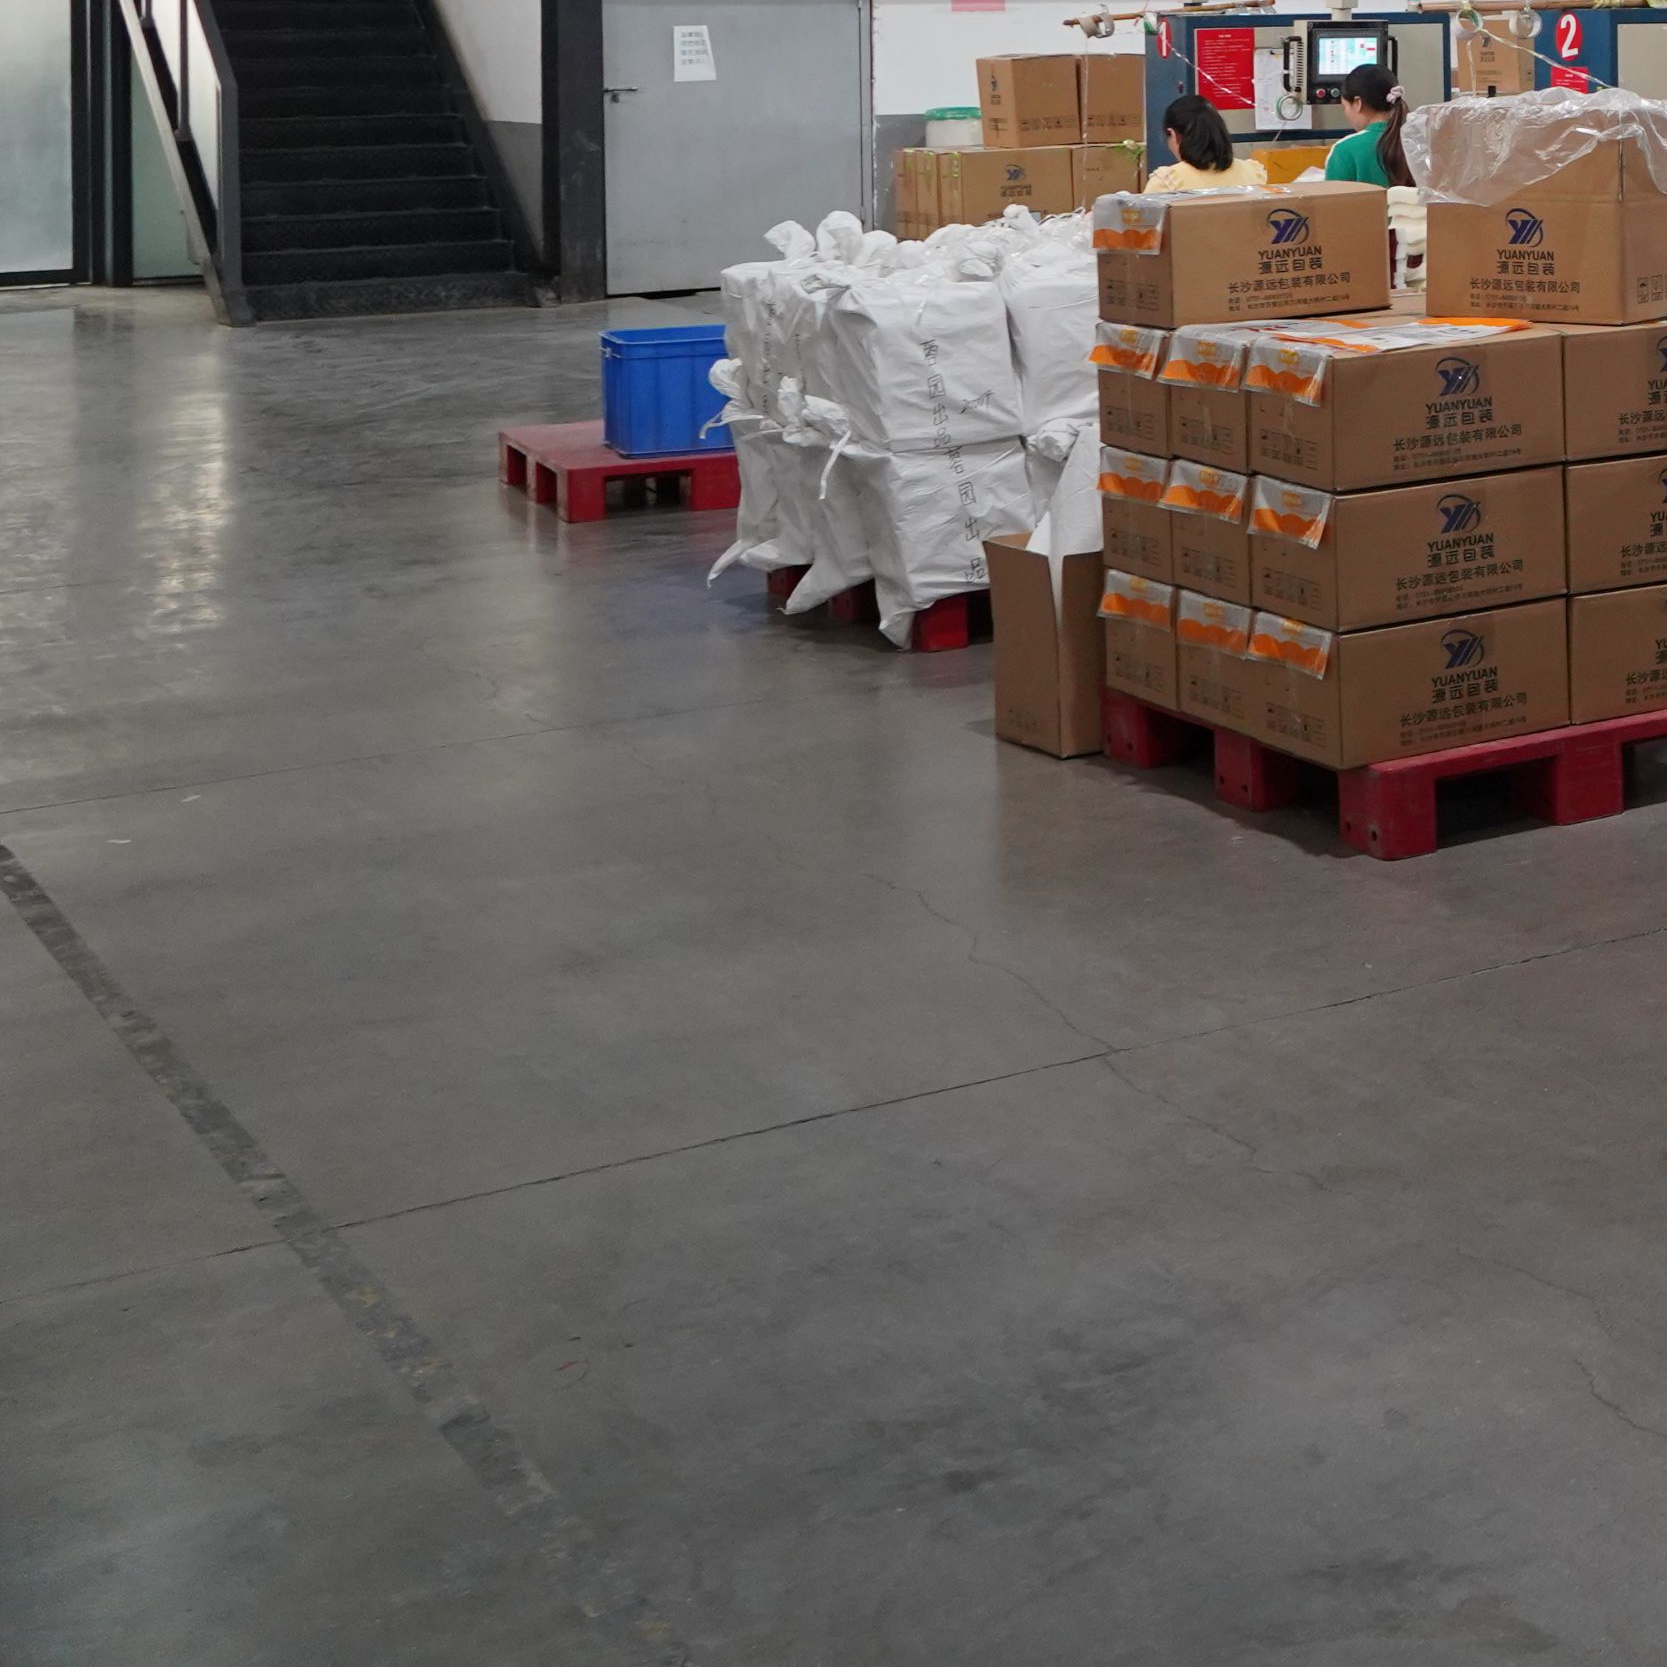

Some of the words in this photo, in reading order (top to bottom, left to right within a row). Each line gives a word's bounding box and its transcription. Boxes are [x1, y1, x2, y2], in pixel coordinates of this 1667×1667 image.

[1159, 21, 1168, 56] 1
[1560, 13, 1579, 59] 2
[1258, 246, 1322, 260] YUANYUAN
[1497, 249, 1554, 261] YUANYUAN
[1426, 396, 1492, 414] YUANYUAN
[1427, 533, 1494, 552] YUANYUAN
[1432, 666, 1498, 688] YUANYUAN
